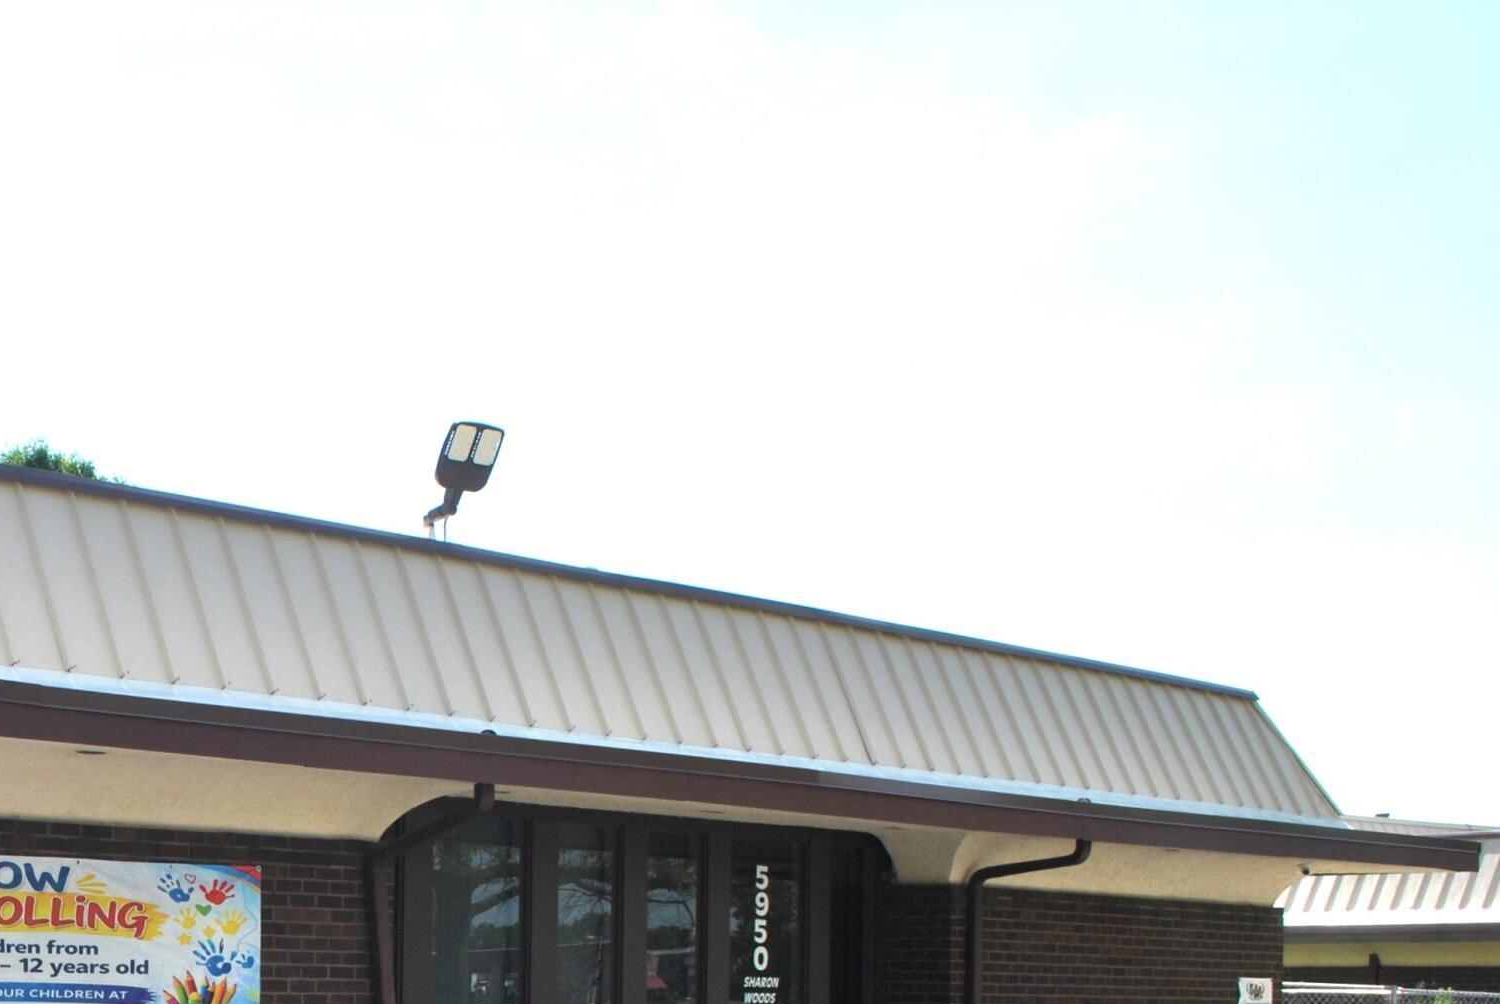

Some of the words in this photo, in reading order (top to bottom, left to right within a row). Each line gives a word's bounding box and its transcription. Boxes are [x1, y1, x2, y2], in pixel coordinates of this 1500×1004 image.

[753, 864, 770, 972] 5950
[46, 939, 99, 955] from
[19, 958, 44, 973] 12
[50, 961, 110, 977] years
[115, 960, 149, 975] old
[743, 976, 780, 988] SHARON
[29, 989, 105, 1000] CHILDREN
[108, 990, 129, 1000] AT
[743, 992, 777, 1004] WOODS
